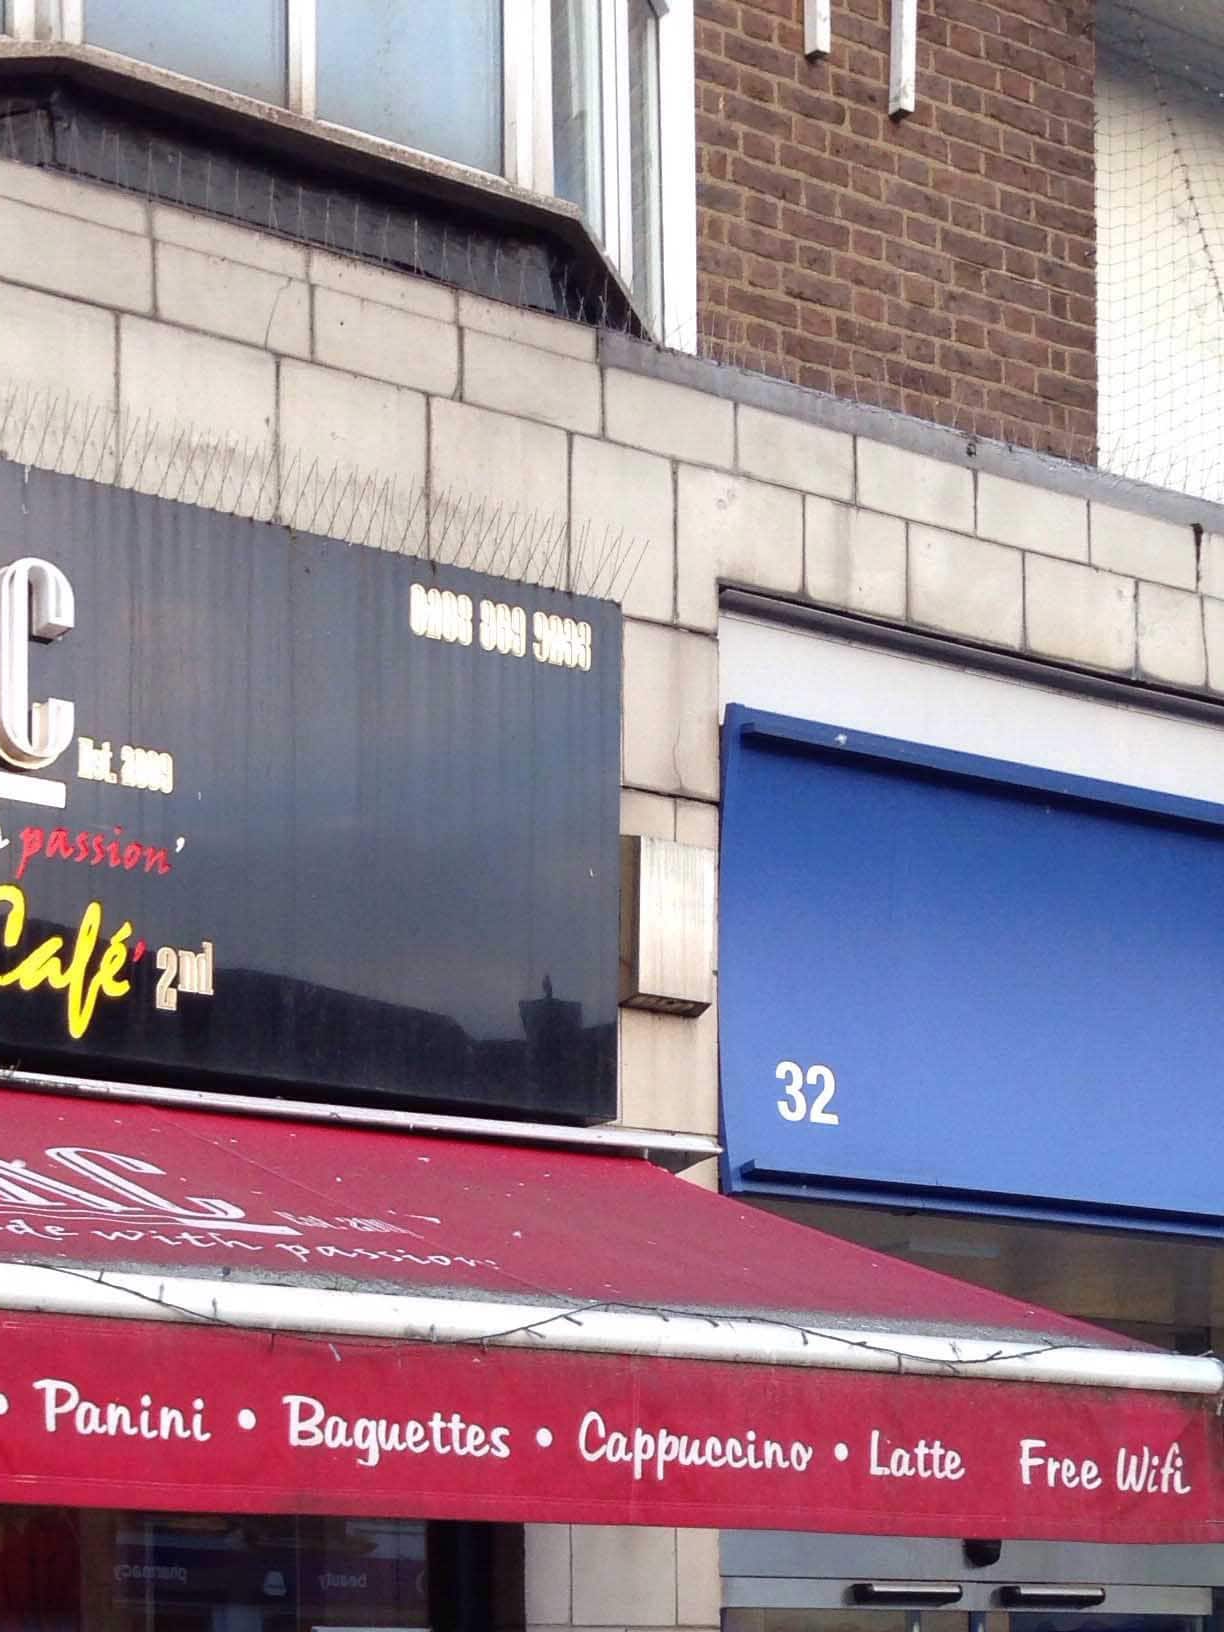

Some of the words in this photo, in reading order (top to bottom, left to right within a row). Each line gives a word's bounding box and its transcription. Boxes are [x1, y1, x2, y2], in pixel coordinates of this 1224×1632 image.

[155, 940, 215, 1012] 2nd
[775, 1060, 840, 1126] 32
[92, 1228, 264, 1252] with
[33, 1378, 211, 1442] Panini
[282, 1395, 510, 1467] Baguettes
[578, 1411, 813, 1481] Cappuccino
[870, 1430, 965, 1480] Latte
[1019, 1438, 1102, 1490] Free
[1116, 1443, 1191, 1494] Wifi
